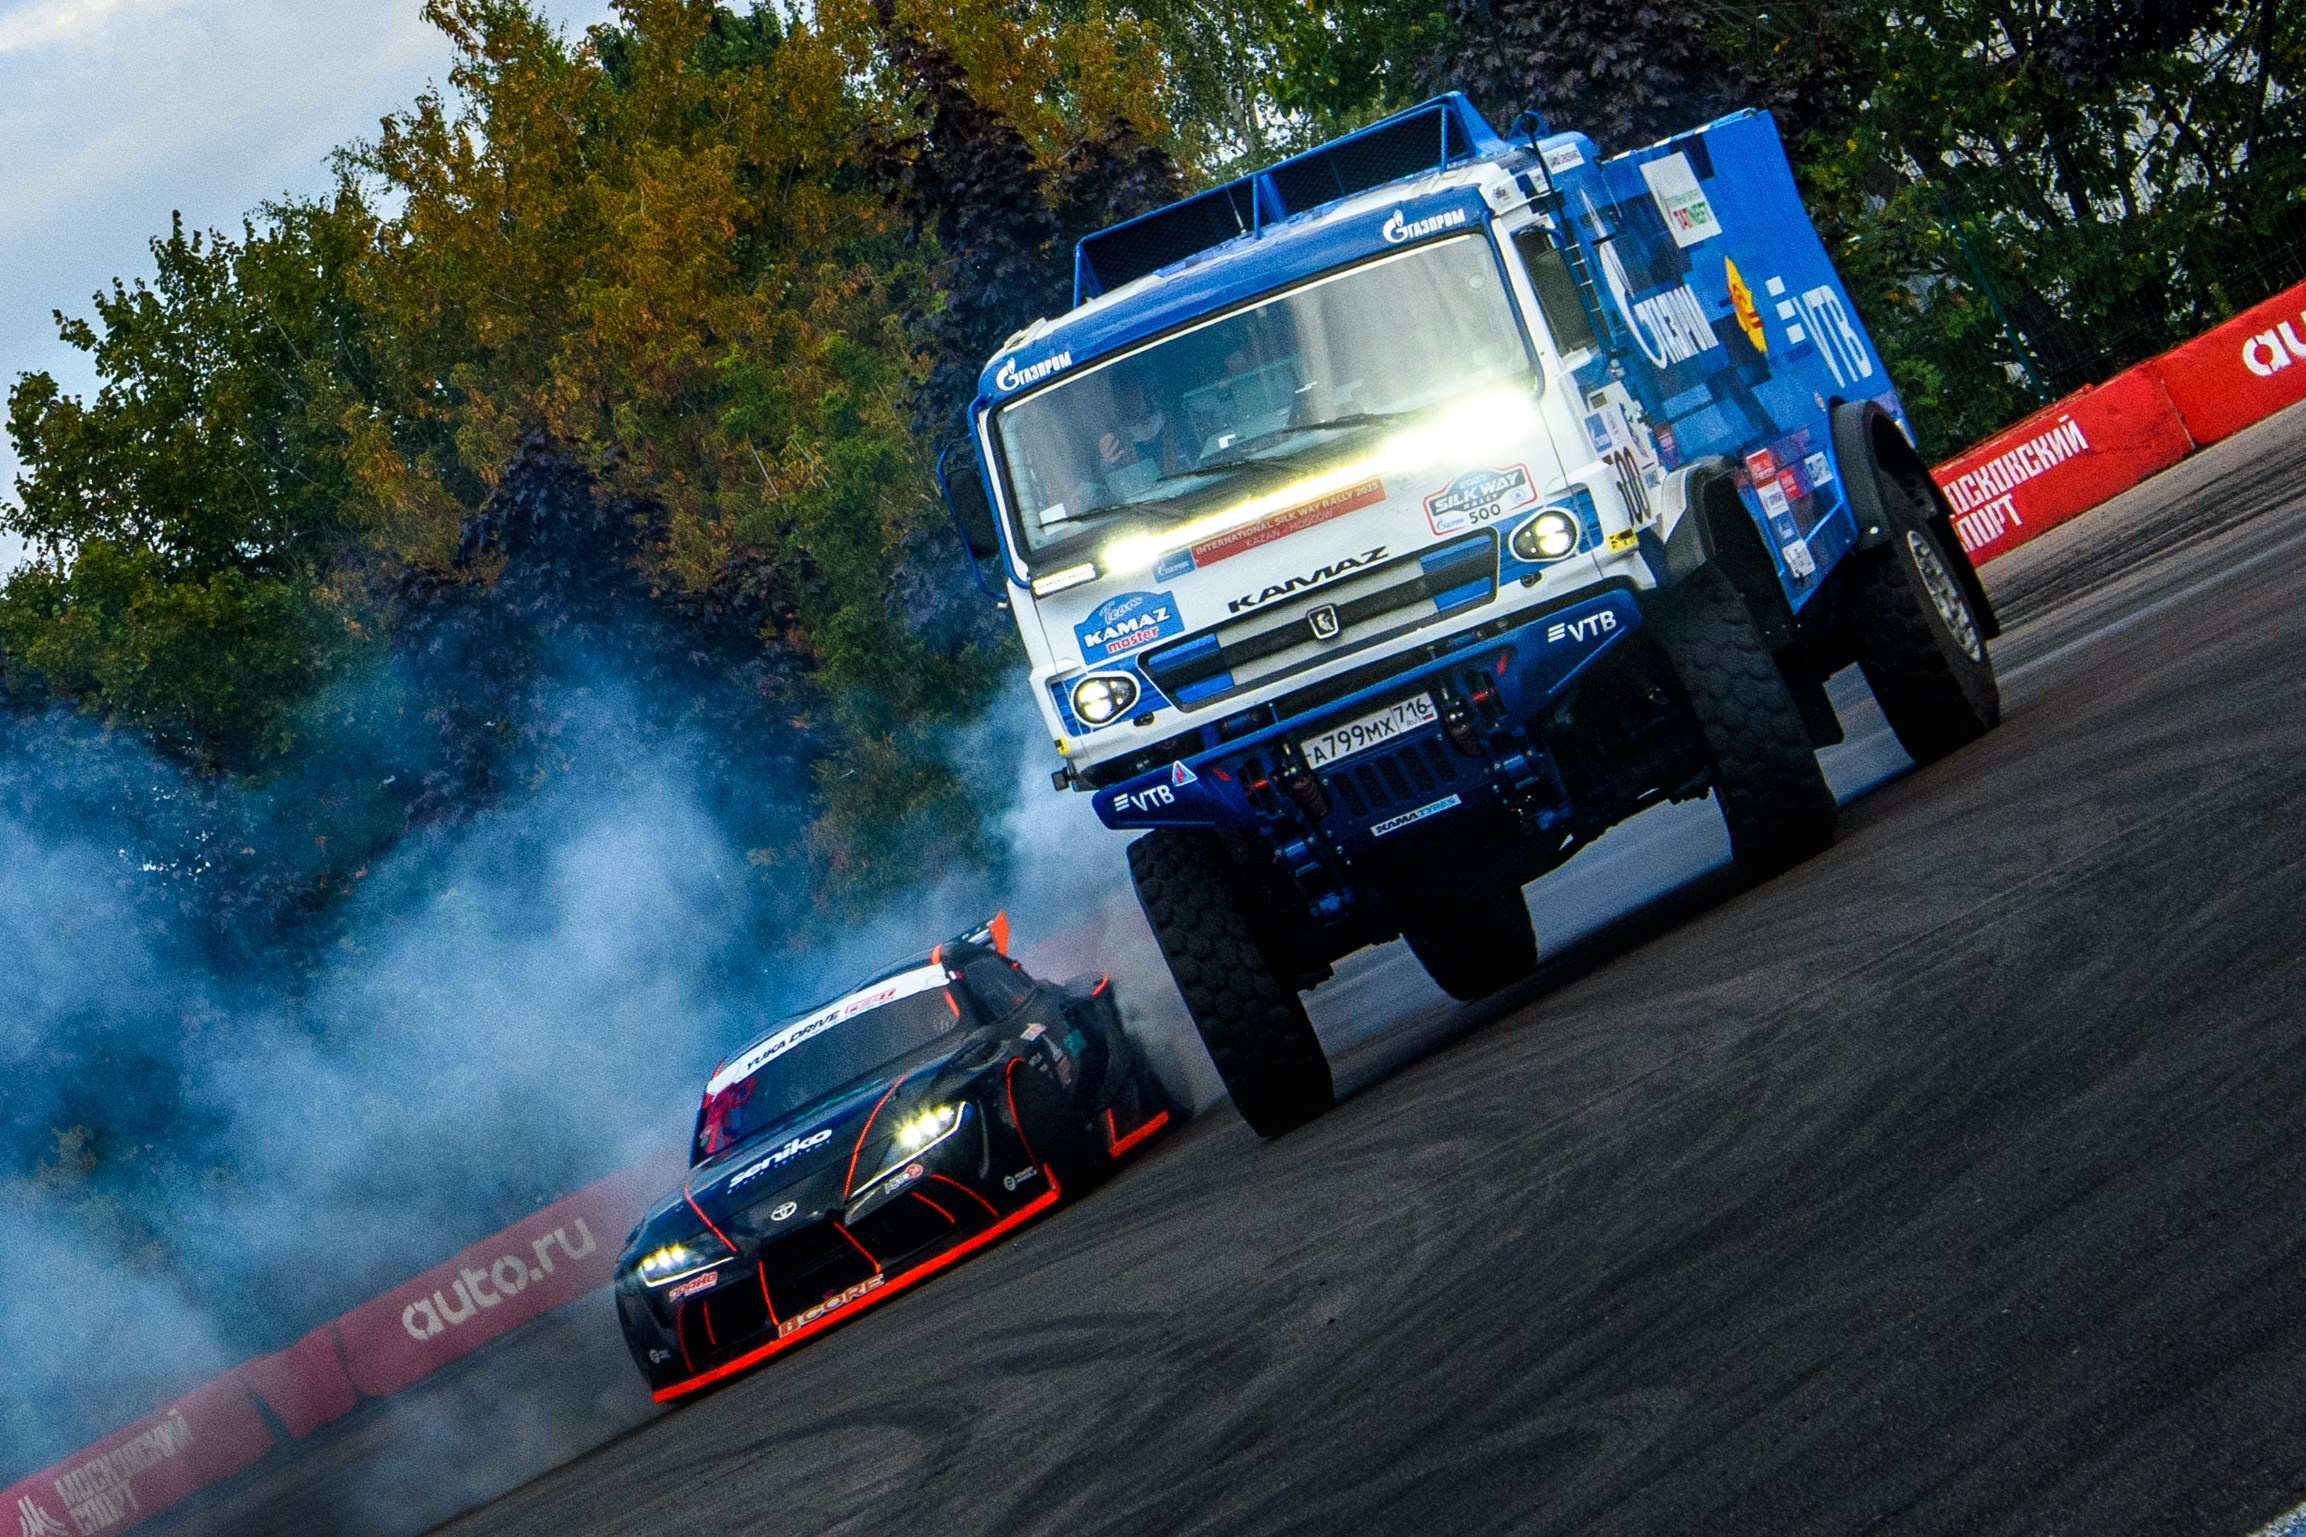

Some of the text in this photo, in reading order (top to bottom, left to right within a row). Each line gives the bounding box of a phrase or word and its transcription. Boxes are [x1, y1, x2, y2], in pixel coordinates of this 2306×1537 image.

[1407, 208, 1466, 239] ГАЗПРОМ
[1791, 285, 1873, 389] VTB
[1018, 351, 1072, 386] ГАЗПРОМ
[1942, 414, 2090, 516] ОСКОВСКИЙ
[1434, 472, 1519, 514] SILK WAY
[1196, 520, 1275, 555] INTERNATIONAL
[1274, 511, 1297, 526] SILK
[1299, 503, 1320, 517] WAY
[1322, 490, 1353, 508] RALLY
[1246, 529, 1281, 547] KAZAN
[1289, 509, 1334, 532] MOSCOW
[1468, 503, 1501, 524] 500
[1949, 494, 2023, 553] ПОРТ
[1227, 545, 1389, 614] KAMAZ
[1084, 607, 1170, 648] KAMAZ
[1099, 597, 1143, 625] Team
[1567, 610, 1617, 642] VTB
[1106, 626, 1159, 654] master
[1393, 698, 1428, 723] 716
[1130, 784, 1175, 811] VTB
[729, 1129, 833, 1189] seniko
[402, 1217, 598, 1341] auto.ru
